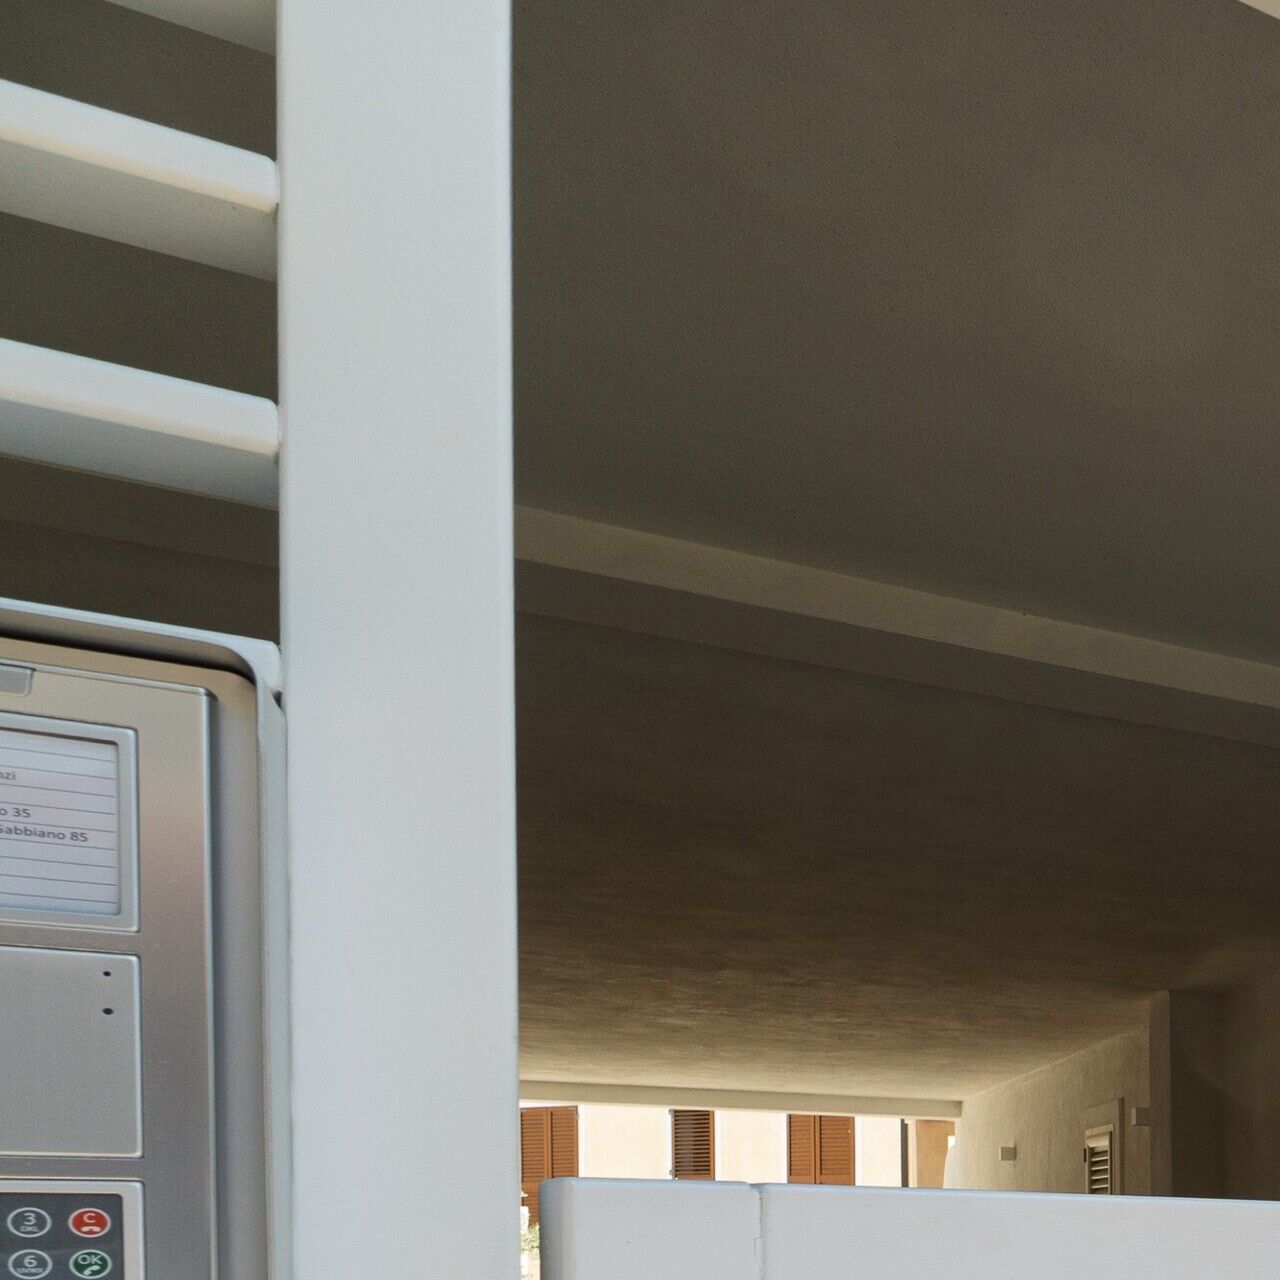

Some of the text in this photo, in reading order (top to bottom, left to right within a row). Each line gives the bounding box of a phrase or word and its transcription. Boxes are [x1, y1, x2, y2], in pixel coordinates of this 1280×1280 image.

[12, 807, 31, 818] 35
[70, 831, 88, 842] 85
[24, 1212, 96, 1226] 3 C
[24, 1254, 103, 1268] 6 OK
